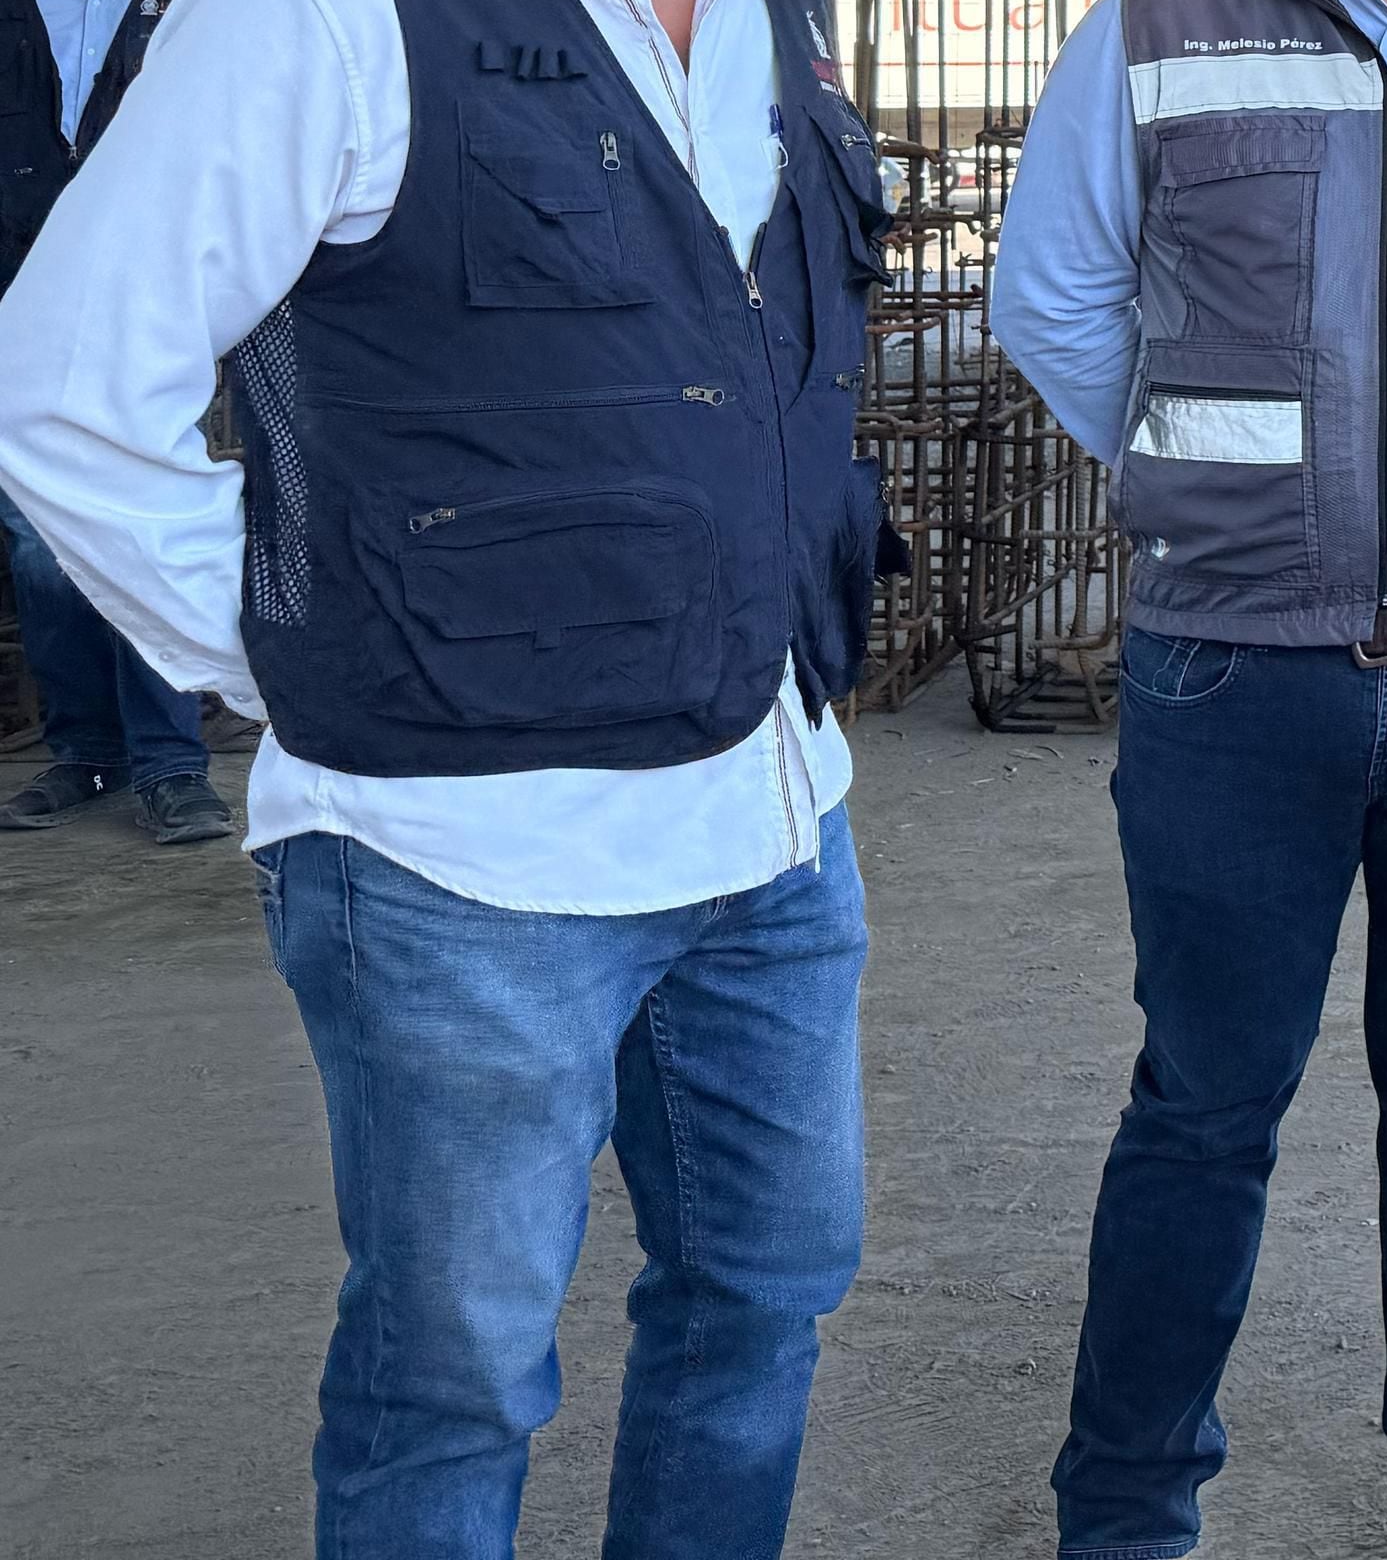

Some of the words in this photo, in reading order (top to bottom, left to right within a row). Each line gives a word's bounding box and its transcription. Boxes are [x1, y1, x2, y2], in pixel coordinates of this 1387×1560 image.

[1184, 39, 1213, 52] Ing.
[1218, 38, 1276, 51] Melesio
[1280, 38, 1323, 50] Pérez
